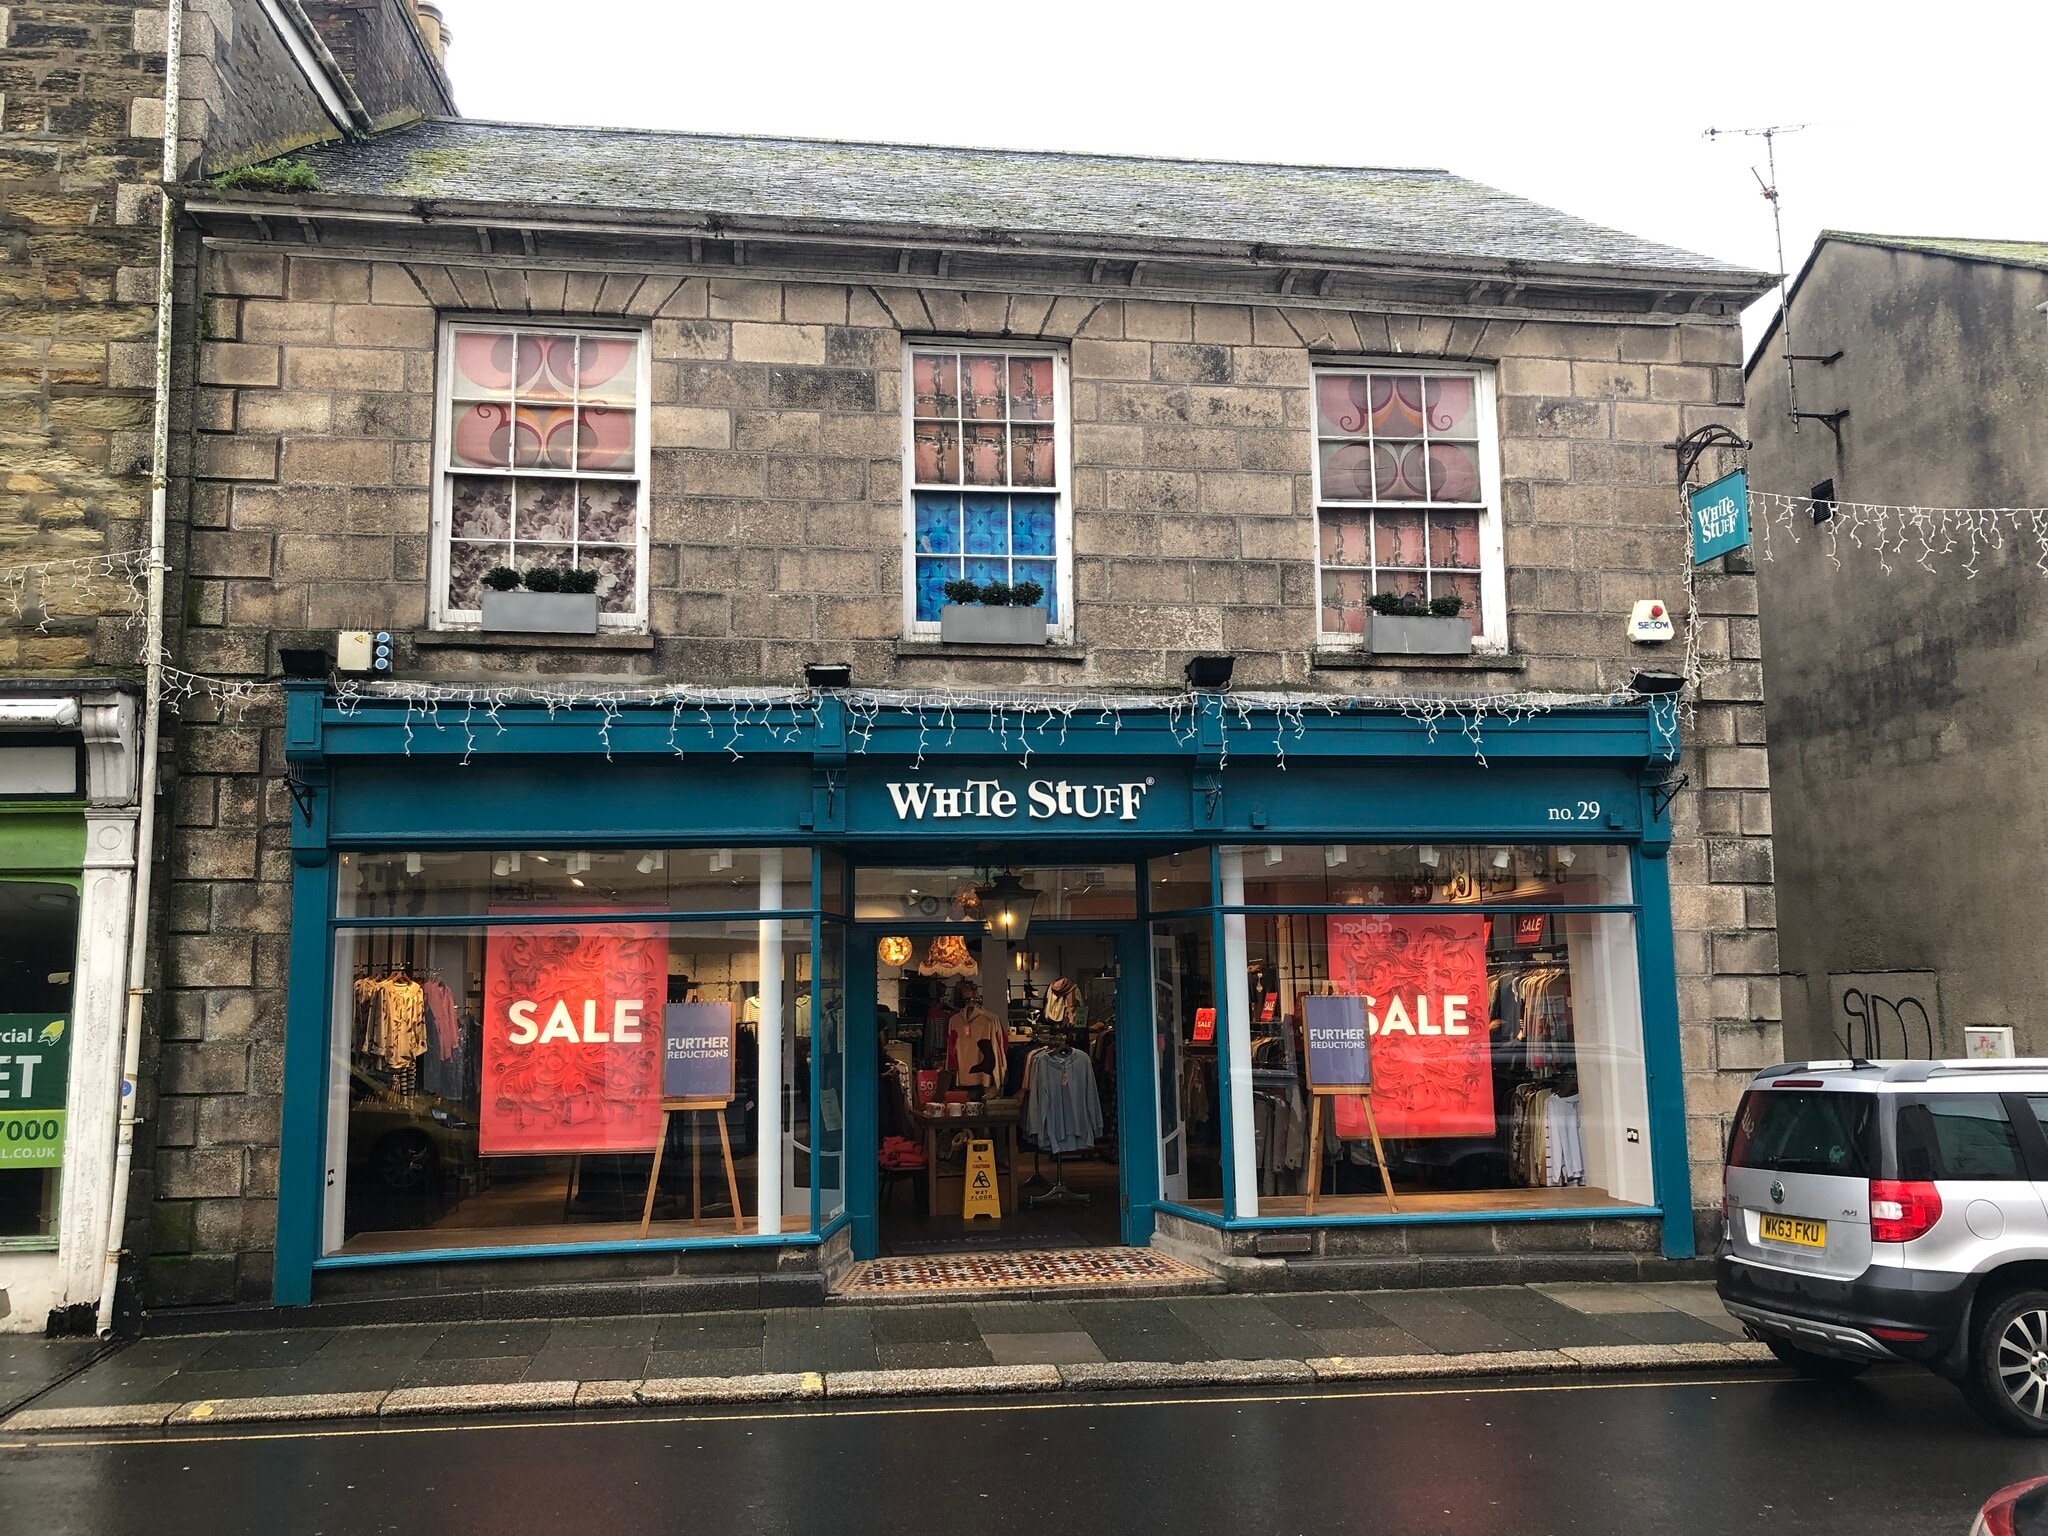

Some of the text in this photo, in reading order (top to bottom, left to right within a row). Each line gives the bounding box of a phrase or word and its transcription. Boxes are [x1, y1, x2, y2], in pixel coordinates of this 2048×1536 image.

[1638, 621, 1669, 629] SECOM
[1547, 801, 1601, 820] no. 29
[1521, 918, 1542, 932] SALE
[508, 999, 644, 1045] SALE
[0, 1028, 33, 1043] cial
[1309, 1029, 1365, 1040] FURTHER
[667, 1036, 729, 1050] FURTHER
[1311, 1041, 1366, 1049] REDUCTIONS
[667, 1050, 729, 1060] REDUCTIONS
[1765, 1217, 1820, 1243] WK63 FKU
